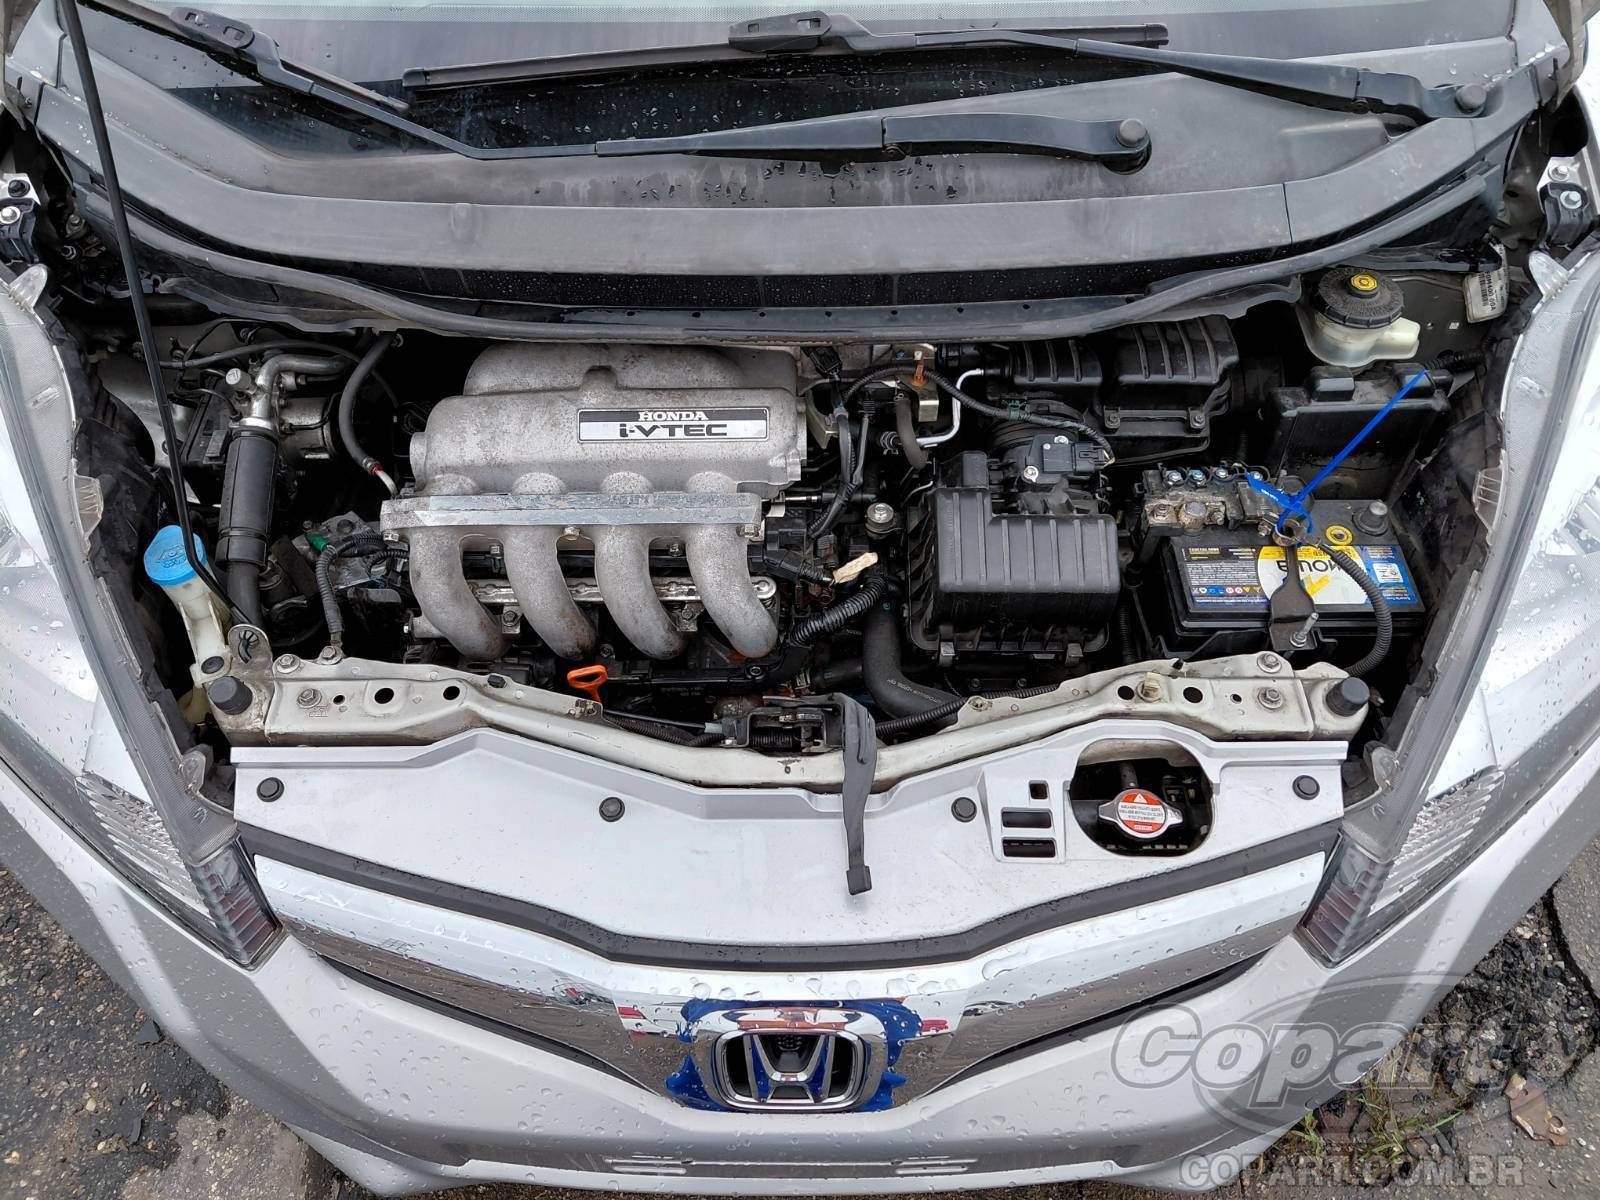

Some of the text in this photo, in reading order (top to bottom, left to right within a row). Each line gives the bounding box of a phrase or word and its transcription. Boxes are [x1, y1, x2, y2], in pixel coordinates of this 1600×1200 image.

[638, 411, 709, 421] HONDA
[619, 423, 728, 438] i-VTEC
[1276, 560, 1344, 574] MOUA
